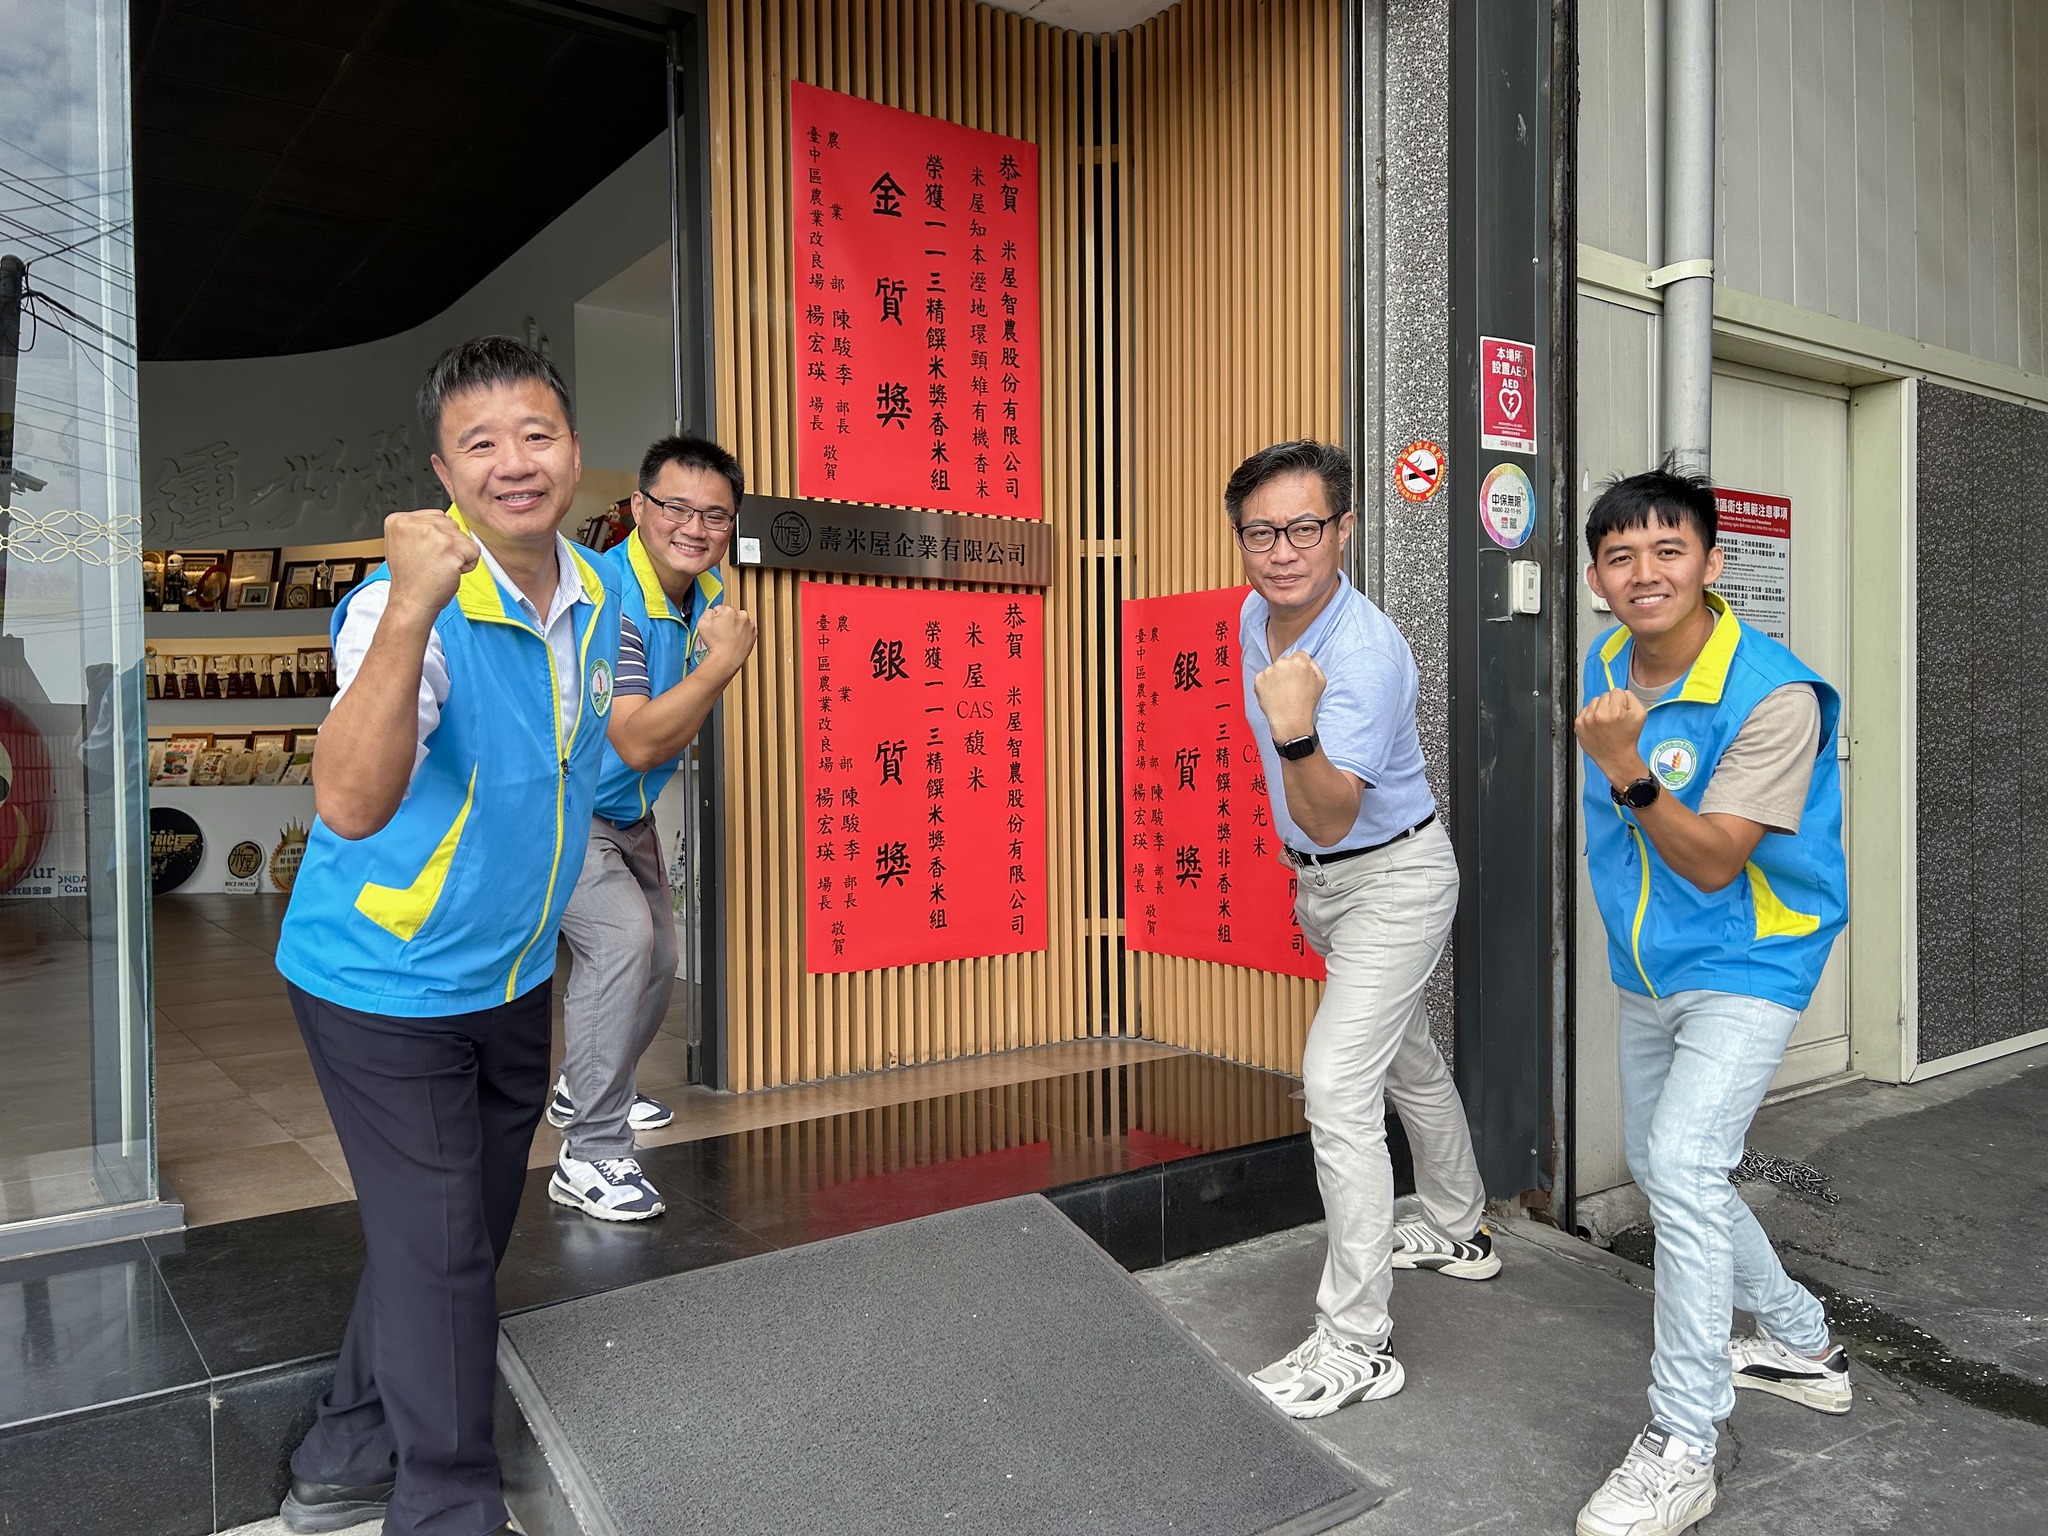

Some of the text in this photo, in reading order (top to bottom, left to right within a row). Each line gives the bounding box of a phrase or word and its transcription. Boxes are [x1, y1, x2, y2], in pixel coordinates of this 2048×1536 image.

[806, 124, 827, 431] 臺中區農業改良場 楊宏瑛 場長
[827, 130, 853, 434] 農業部 陳駿季 部長
[869, 171, 913, 431] 金質獎
[924, 153, 951, 491] 榮獲一一三精饌米獎香米組
[997, 152, 1024, 500] 恭賀 米屋智農股份有限公司
[1492, 360, 1528, 378] 設置AED
[1497, 347, 1523, 363] 本場所
[1502, 378, 1519, 390] AED
[818, 525, 1026, 568] 壽米屋企業有限公司
[823, 444, 838, 481] 敬賀
[815, 613, 836, 911] 臺中區農業改良場 楊宏瑛 場長
[836, 615, 861, 909] 農業部 陳駿季 部長
[869, 638, 912, 889] 銀質獎
[924, 620, 948, 929] 榮獲一一三精饌米獎香米組
[1002, 602, 1027, 936] 恭賀 米屋智農股份有限公司
[1132, 628, 1149, 894] 臺中區農業改良場 楊宏瑛 場長
[1149, 626, 1165, 896] 農業部 陳駿季 部長
[1172, 650, 1204, 890] 銀質獎
[1214, 620, 1232, 943] 榮獲一一三精饌米獎非香米組
[831, 920, 846, 955] 敬賀
[1145, 903, 1158, 936] 敬賀
